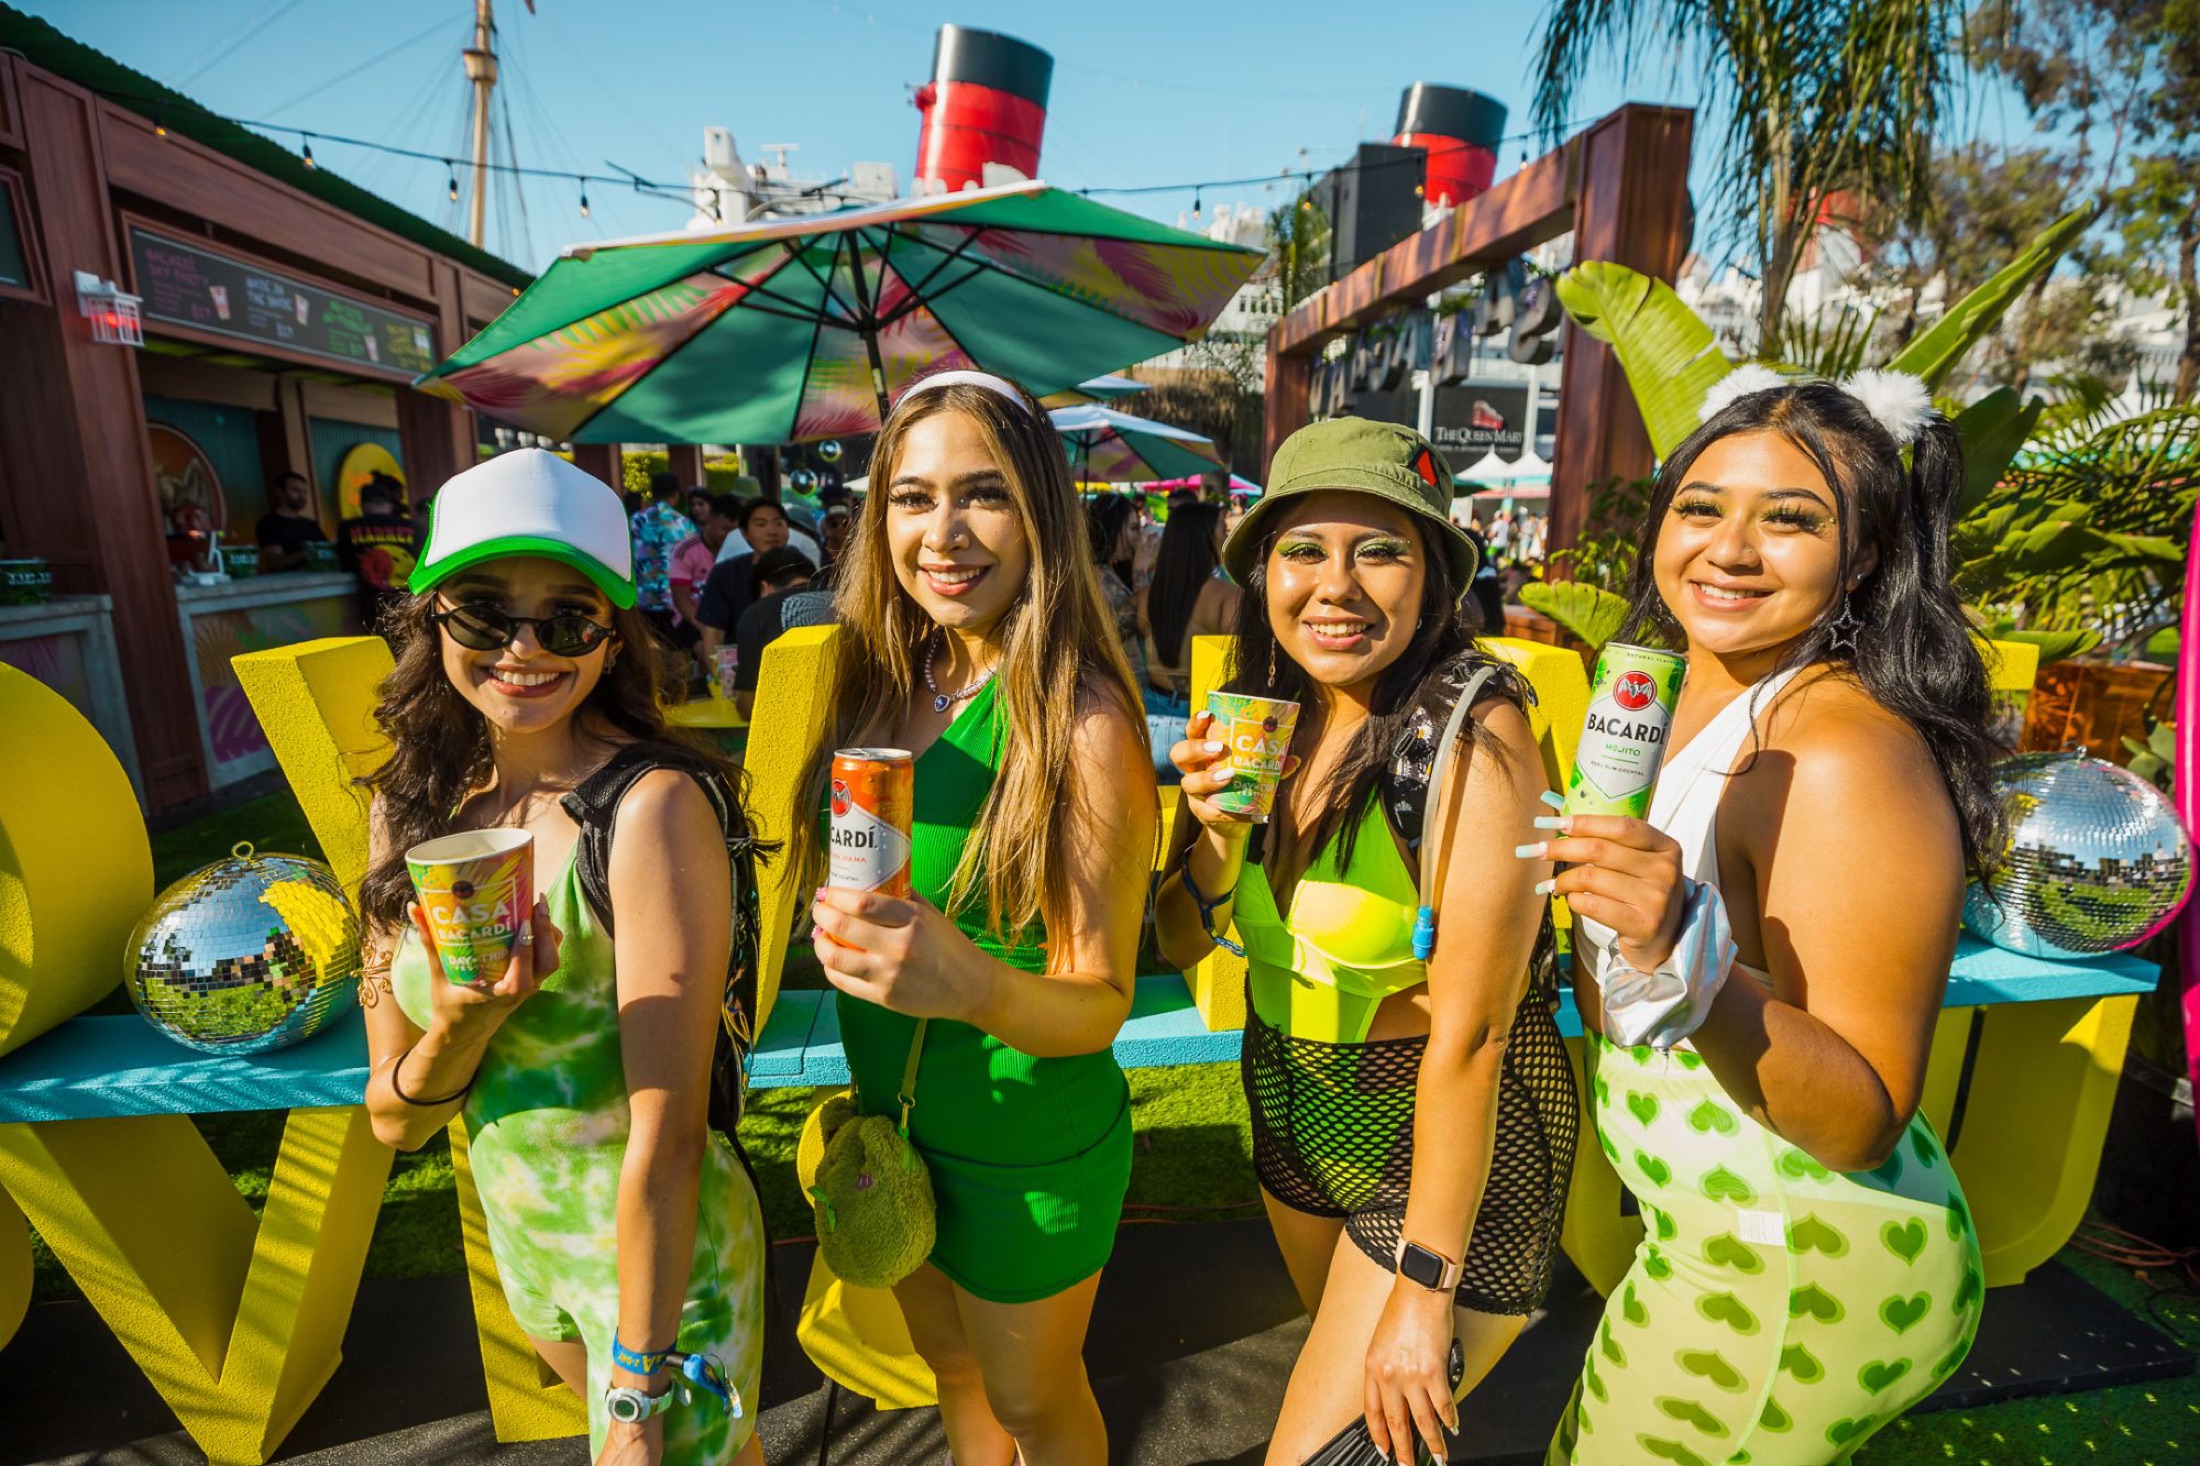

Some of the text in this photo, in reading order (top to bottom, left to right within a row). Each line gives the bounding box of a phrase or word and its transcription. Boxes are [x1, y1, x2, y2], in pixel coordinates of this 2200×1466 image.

[1587, 713, 1669, 745] BACARDÍ
[830, 825, 875, 849] CARDÍ
[432, 900, 511, 925] CASA
[438, 917, 512, 941] BACARDÍ
